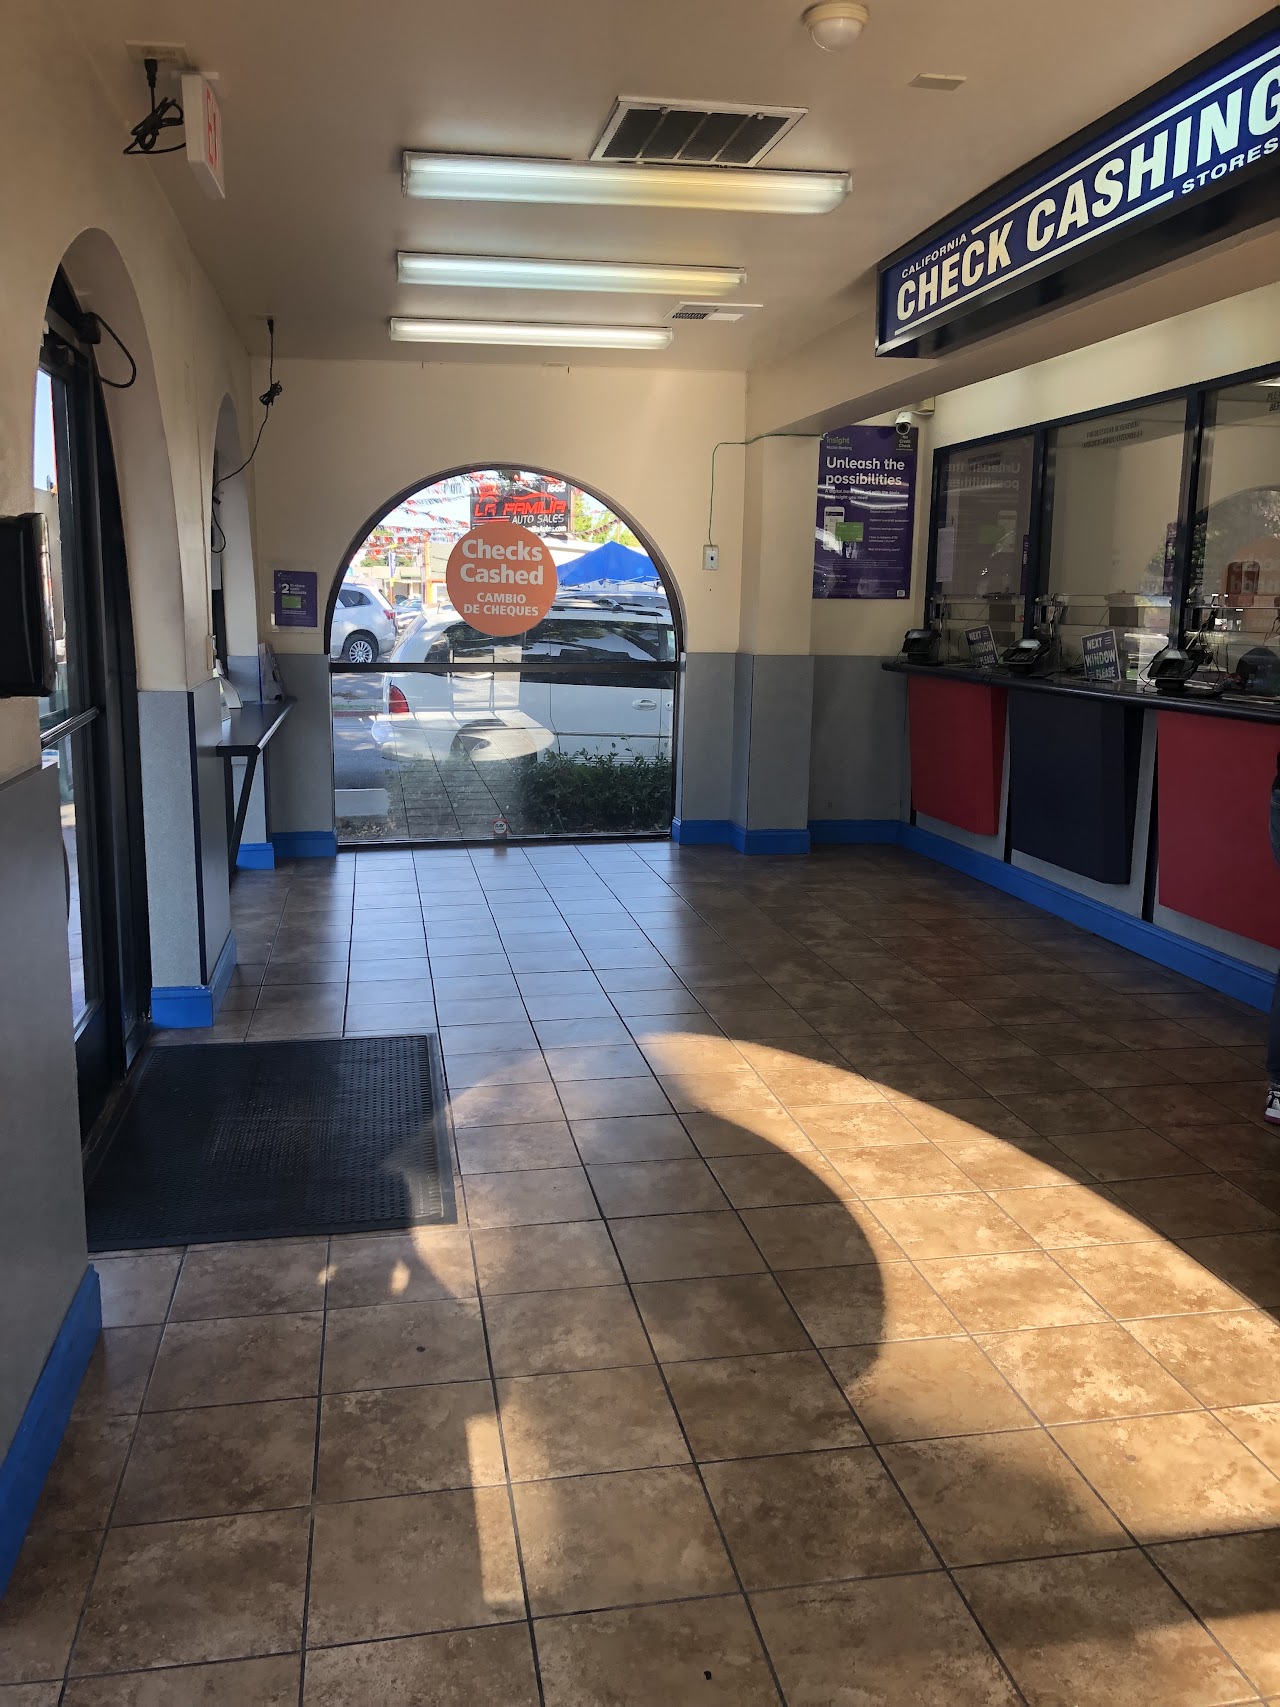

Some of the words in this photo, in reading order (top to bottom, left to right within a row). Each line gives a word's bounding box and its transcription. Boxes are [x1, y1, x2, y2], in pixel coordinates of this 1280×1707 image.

[1181, 137, 1279, 194] STORES
[897, 220, 1014, 321] CHECK
[1026, 64, 1280, 253] CASHING
[901, 233, 967, 279] CALIFORNIA
[826, 456, 880, 469] Unleash
[884, 458, 905, 470] the
[825, 472, 902, 487] possibilities
[547, 481, 566, 493] 1662
[474, 503, 496, 516] LA
[503, 500, 567, 516] FAMILIA
[512, 515, 535, 525] AUTO
[537, 513, 565, 523] SALES
[462, 539, 543, 562] Checks
[460, 563, 544, 585] Cashed
[281, 583, 290, 594] 2
[476, 592, 527, 604] CAMBIO
[463, 604, 480, 614] DE
[483, 604, 539, 617] CHEQUES
[968, 630, 982, 641] NEXT
[1086, 636, 1103, 650] NEXT
[1084, 648, 1116, 668] WINDOW
[1095, 665, 1116, 679] PLEASE
